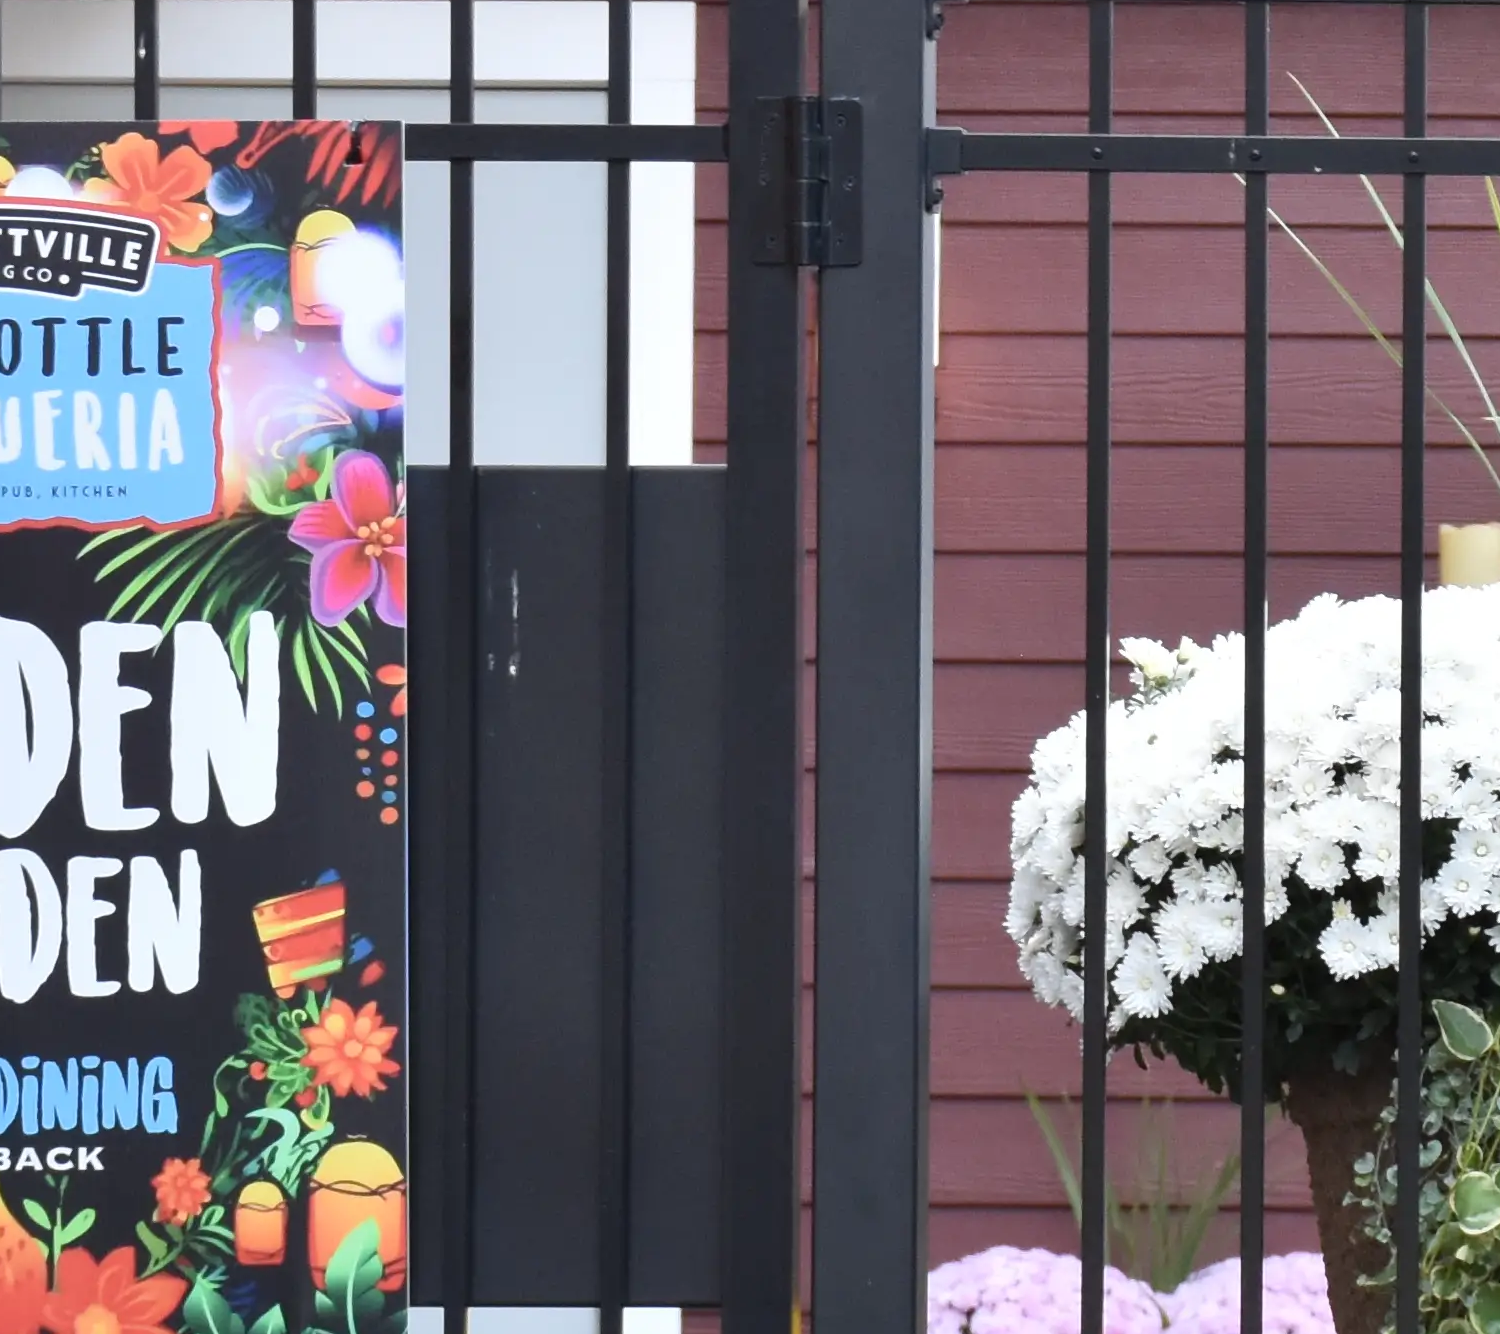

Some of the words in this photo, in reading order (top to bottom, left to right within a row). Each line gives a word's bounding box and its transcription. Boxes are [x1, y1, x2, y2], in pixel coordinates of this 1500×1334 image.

[22, 267, 53, 283] CO
[1, 485, 42, 501] PUB,
[51, 485, 129, 499] KITCHEN
